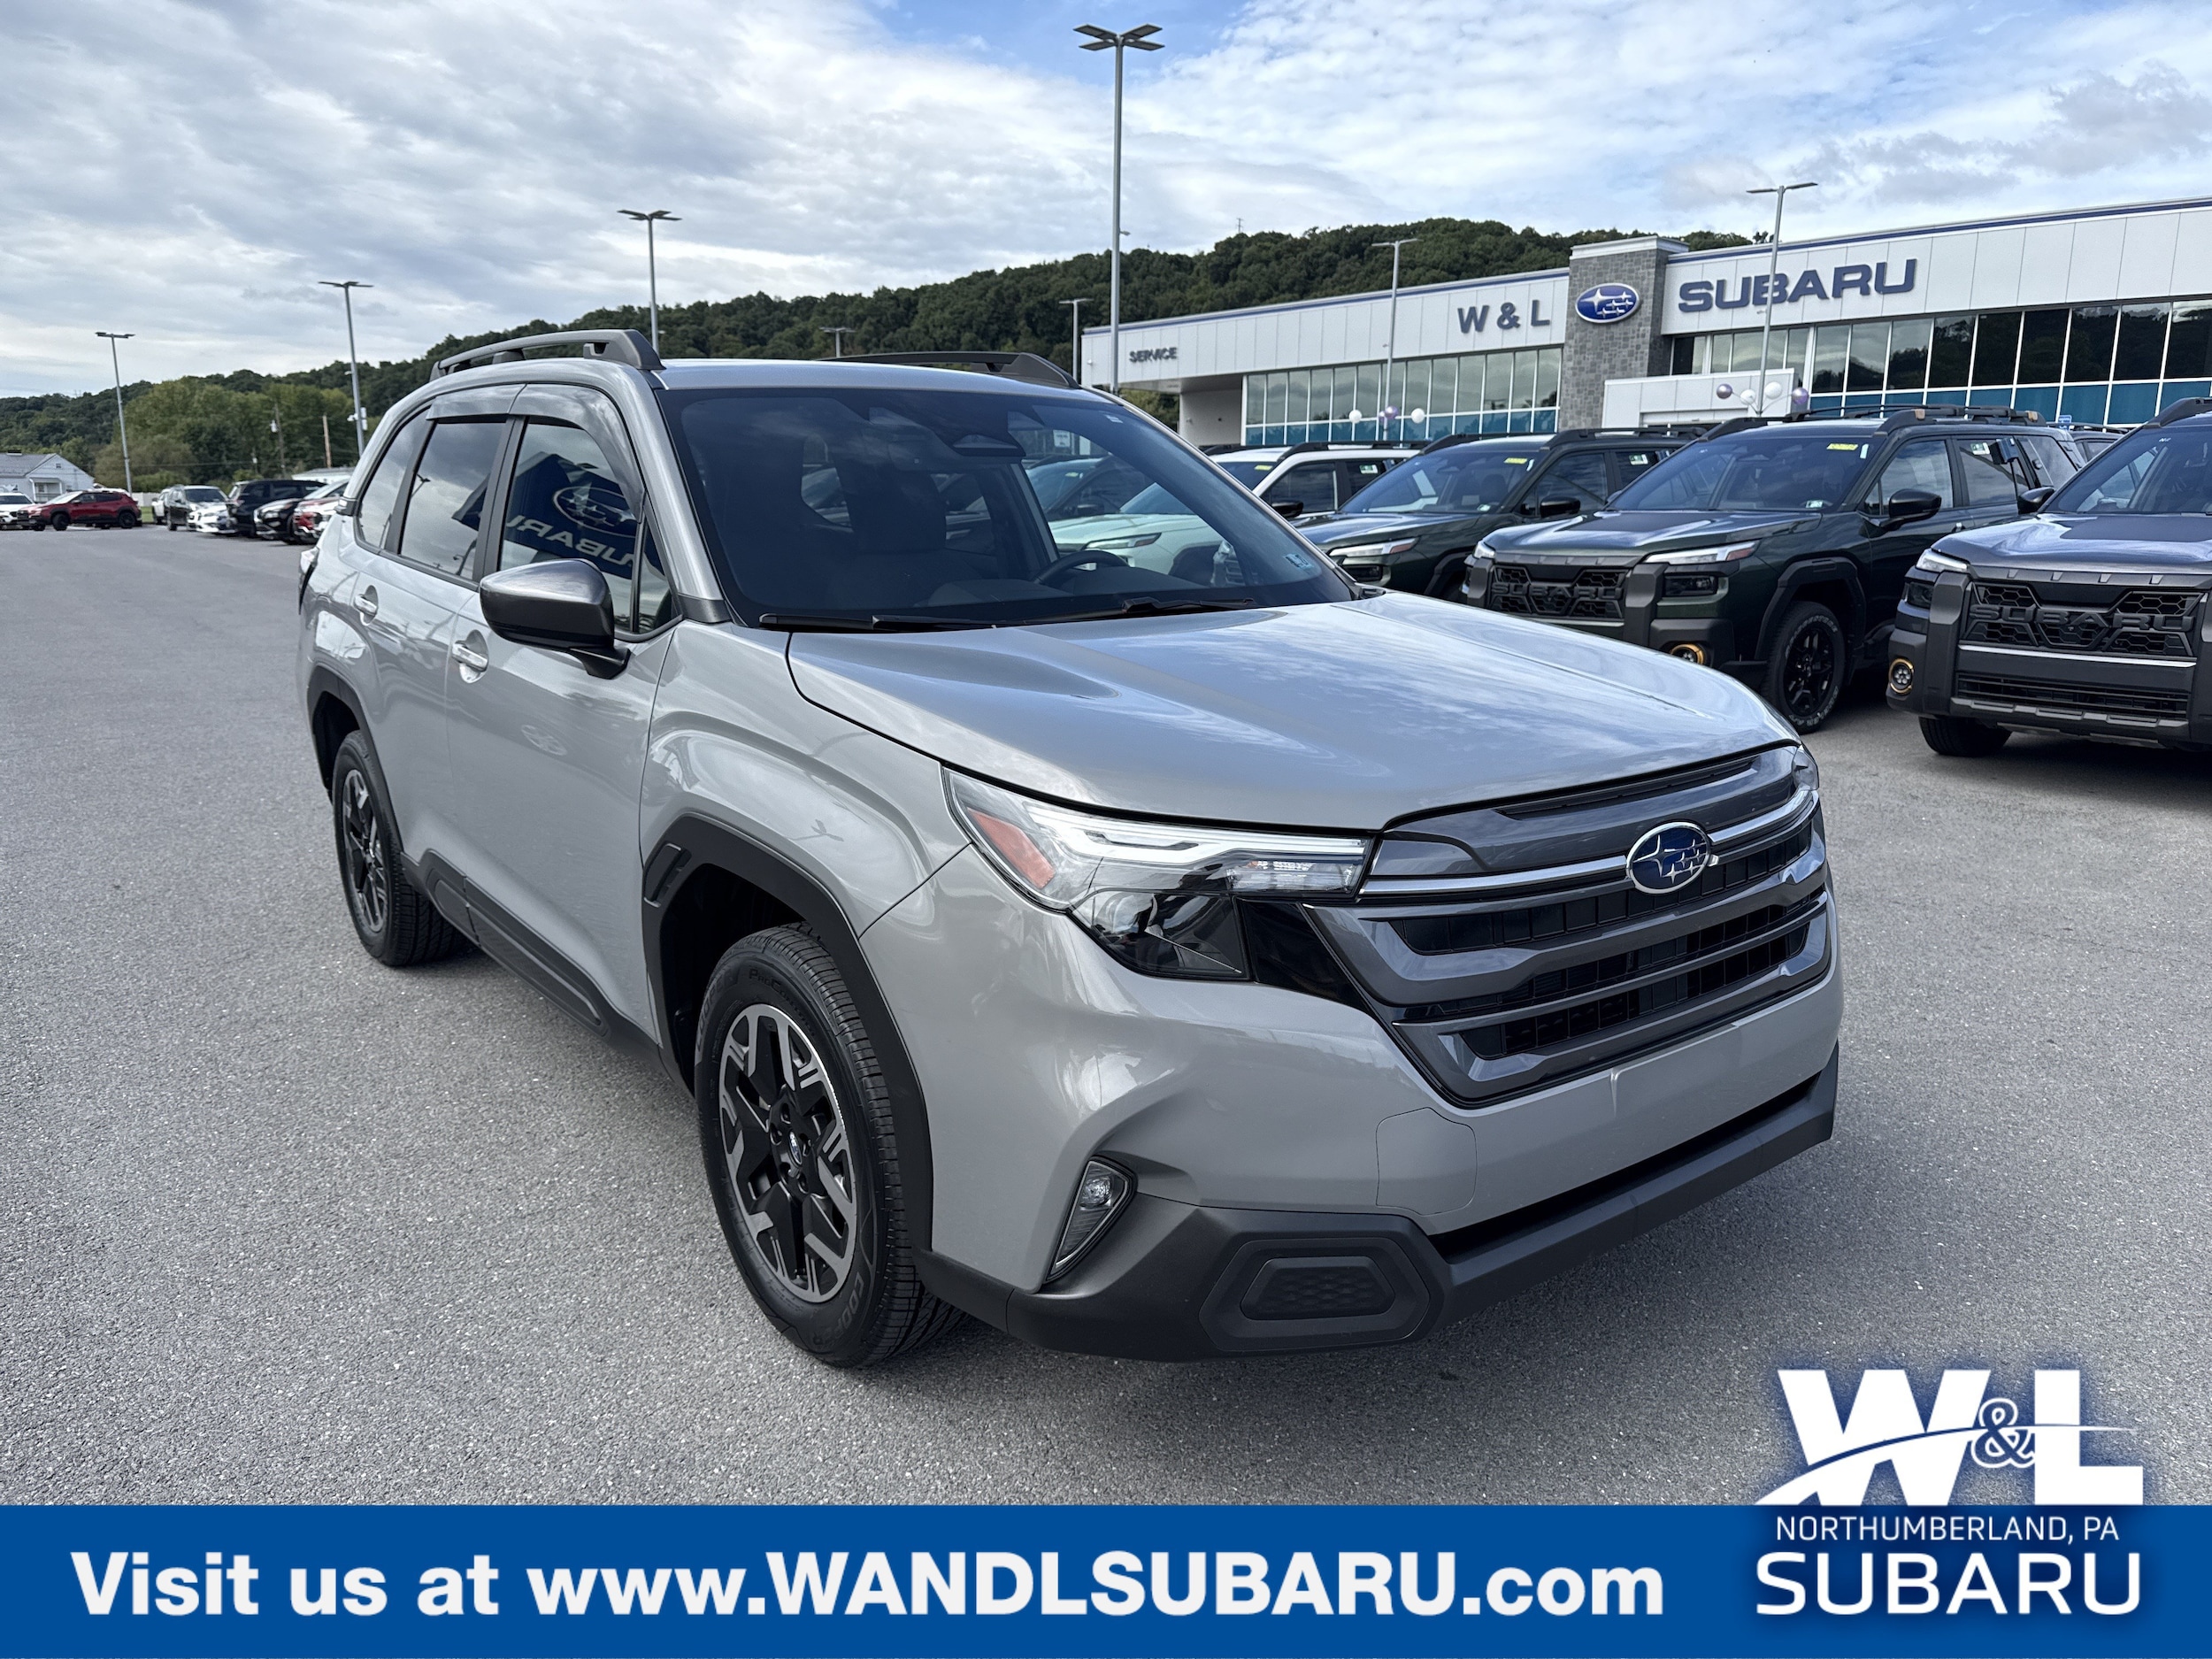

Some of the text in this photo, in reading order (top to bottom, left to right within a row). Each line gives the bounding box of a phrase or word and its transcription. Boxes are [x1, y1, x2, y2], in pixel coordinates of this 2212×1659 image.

[1678, 258, 1917, 312] SUBARU
[1457, 299, 1550, 334] W & L
[1129, 347, 1177, 363] SERVICE
[1492, 582, 1624, 600] SUBARU
[1969, 603, 2194, 634] SUBARU
